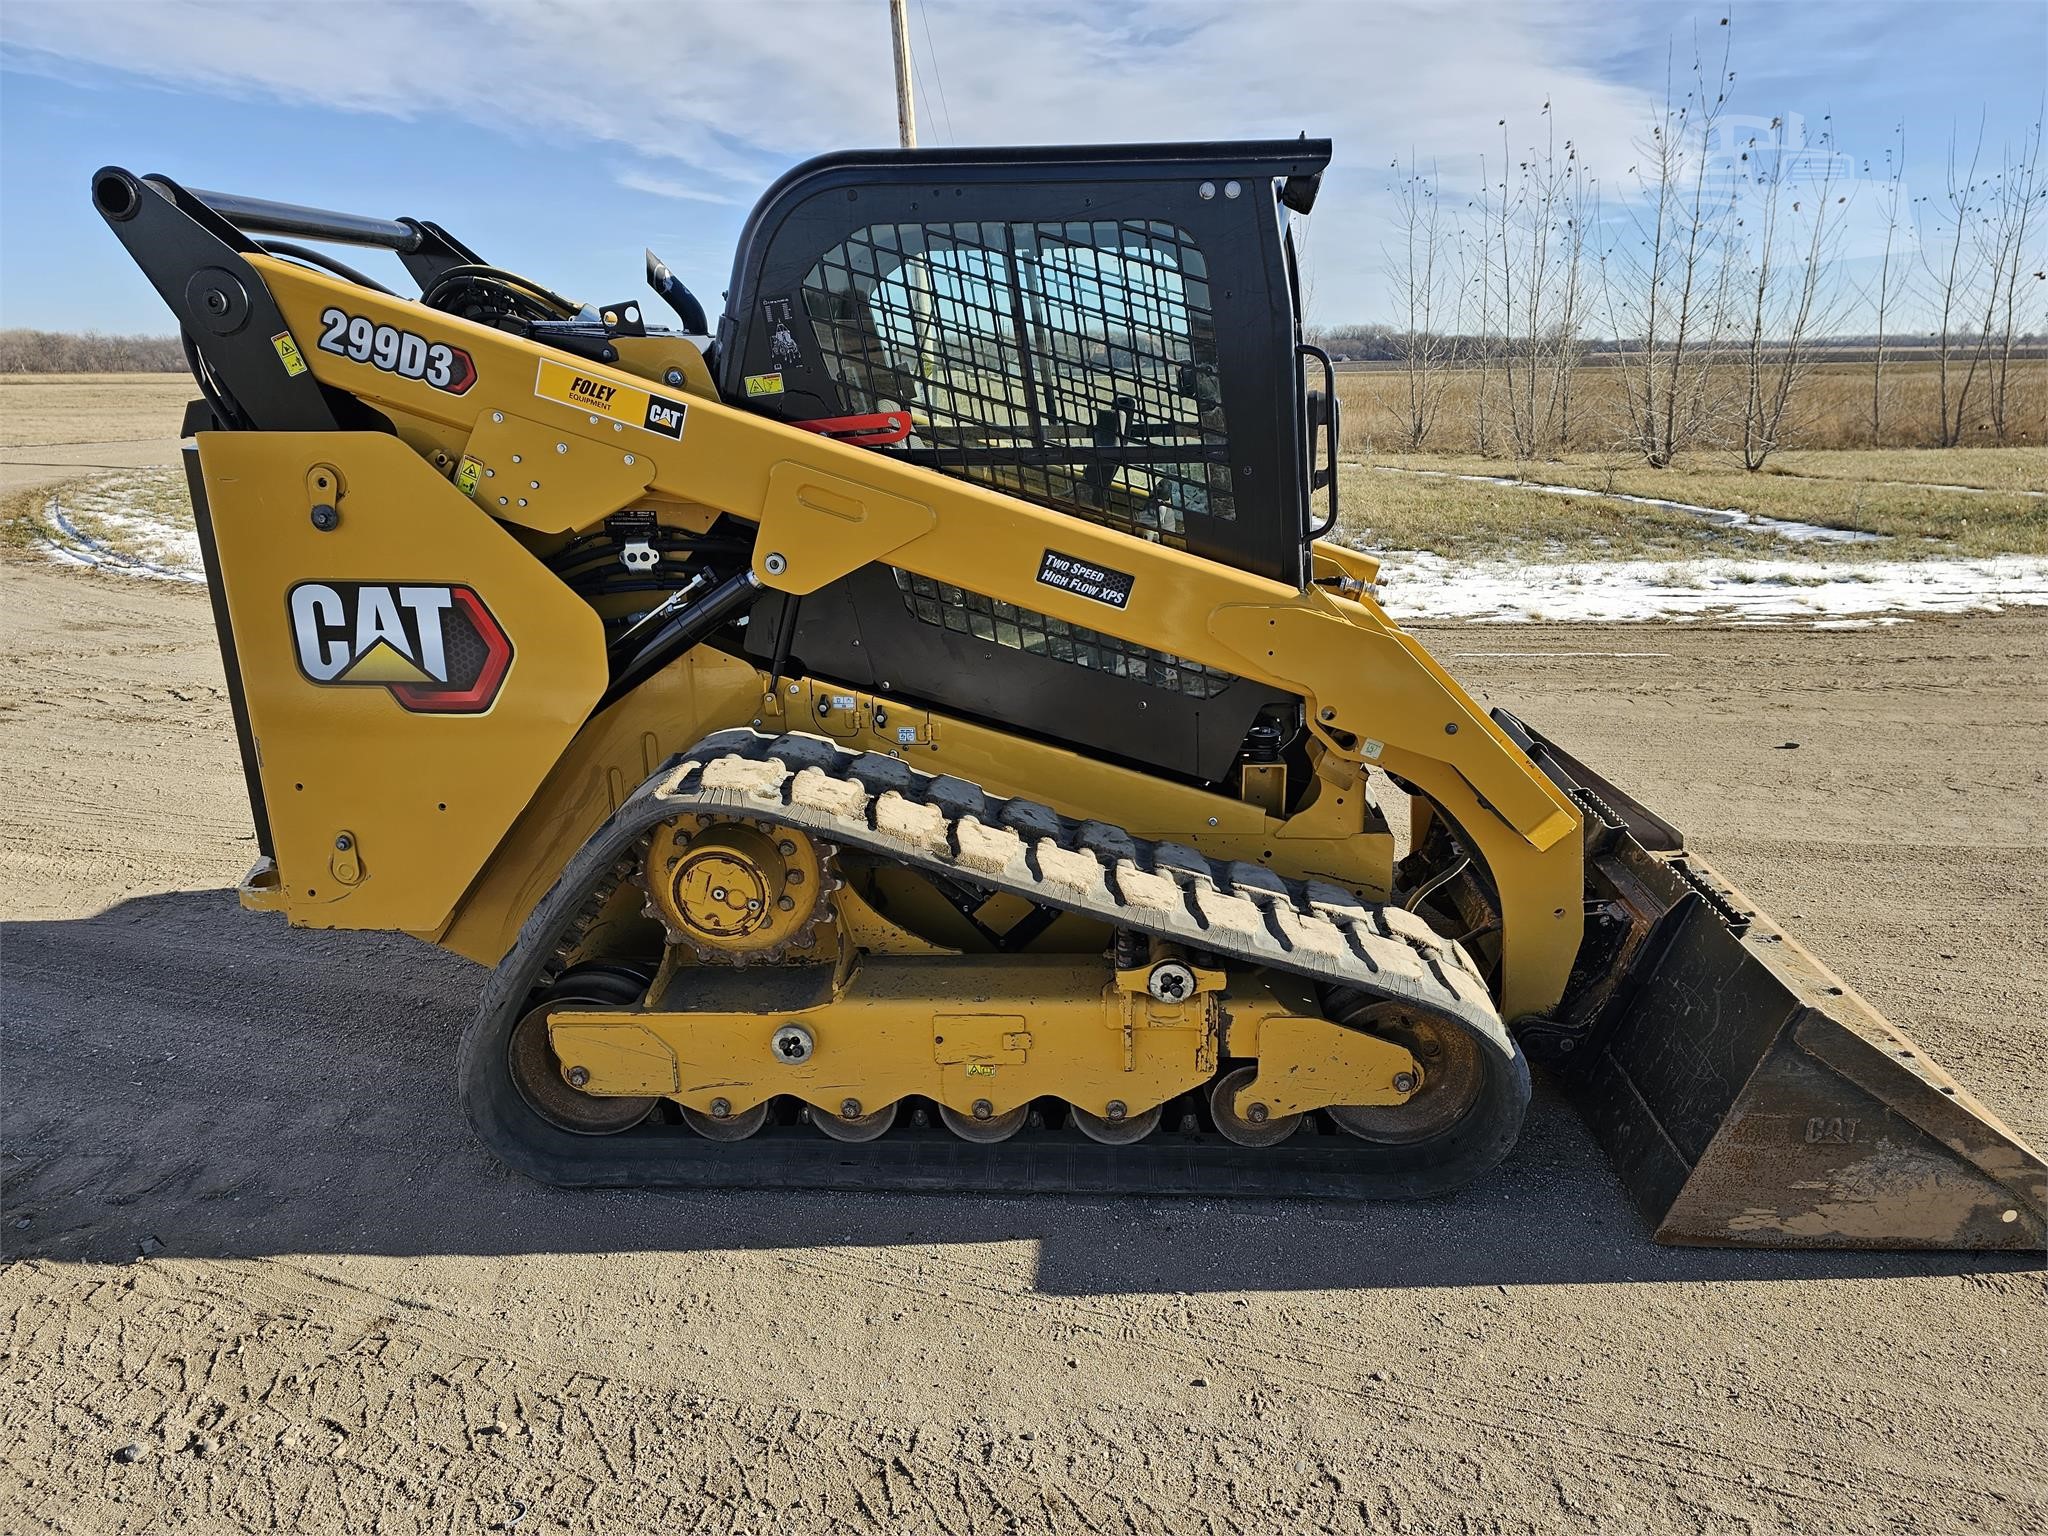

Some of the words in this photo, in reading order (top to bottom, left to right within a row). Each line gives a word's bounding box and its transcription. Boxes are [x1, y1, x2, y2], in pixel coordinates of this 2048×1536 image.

[320, 309, 453, 387] 299D3
[569, 392, 612, 411] EQUIPMENT
[571, 376, 617, 402] FOLEY
[649, 404, 682, 429] CAT
[1098, 588, 1125, 604] XPS
[291, 584, 453, 683] CAT
[1805, 1116, 1861, 1144] CAT
